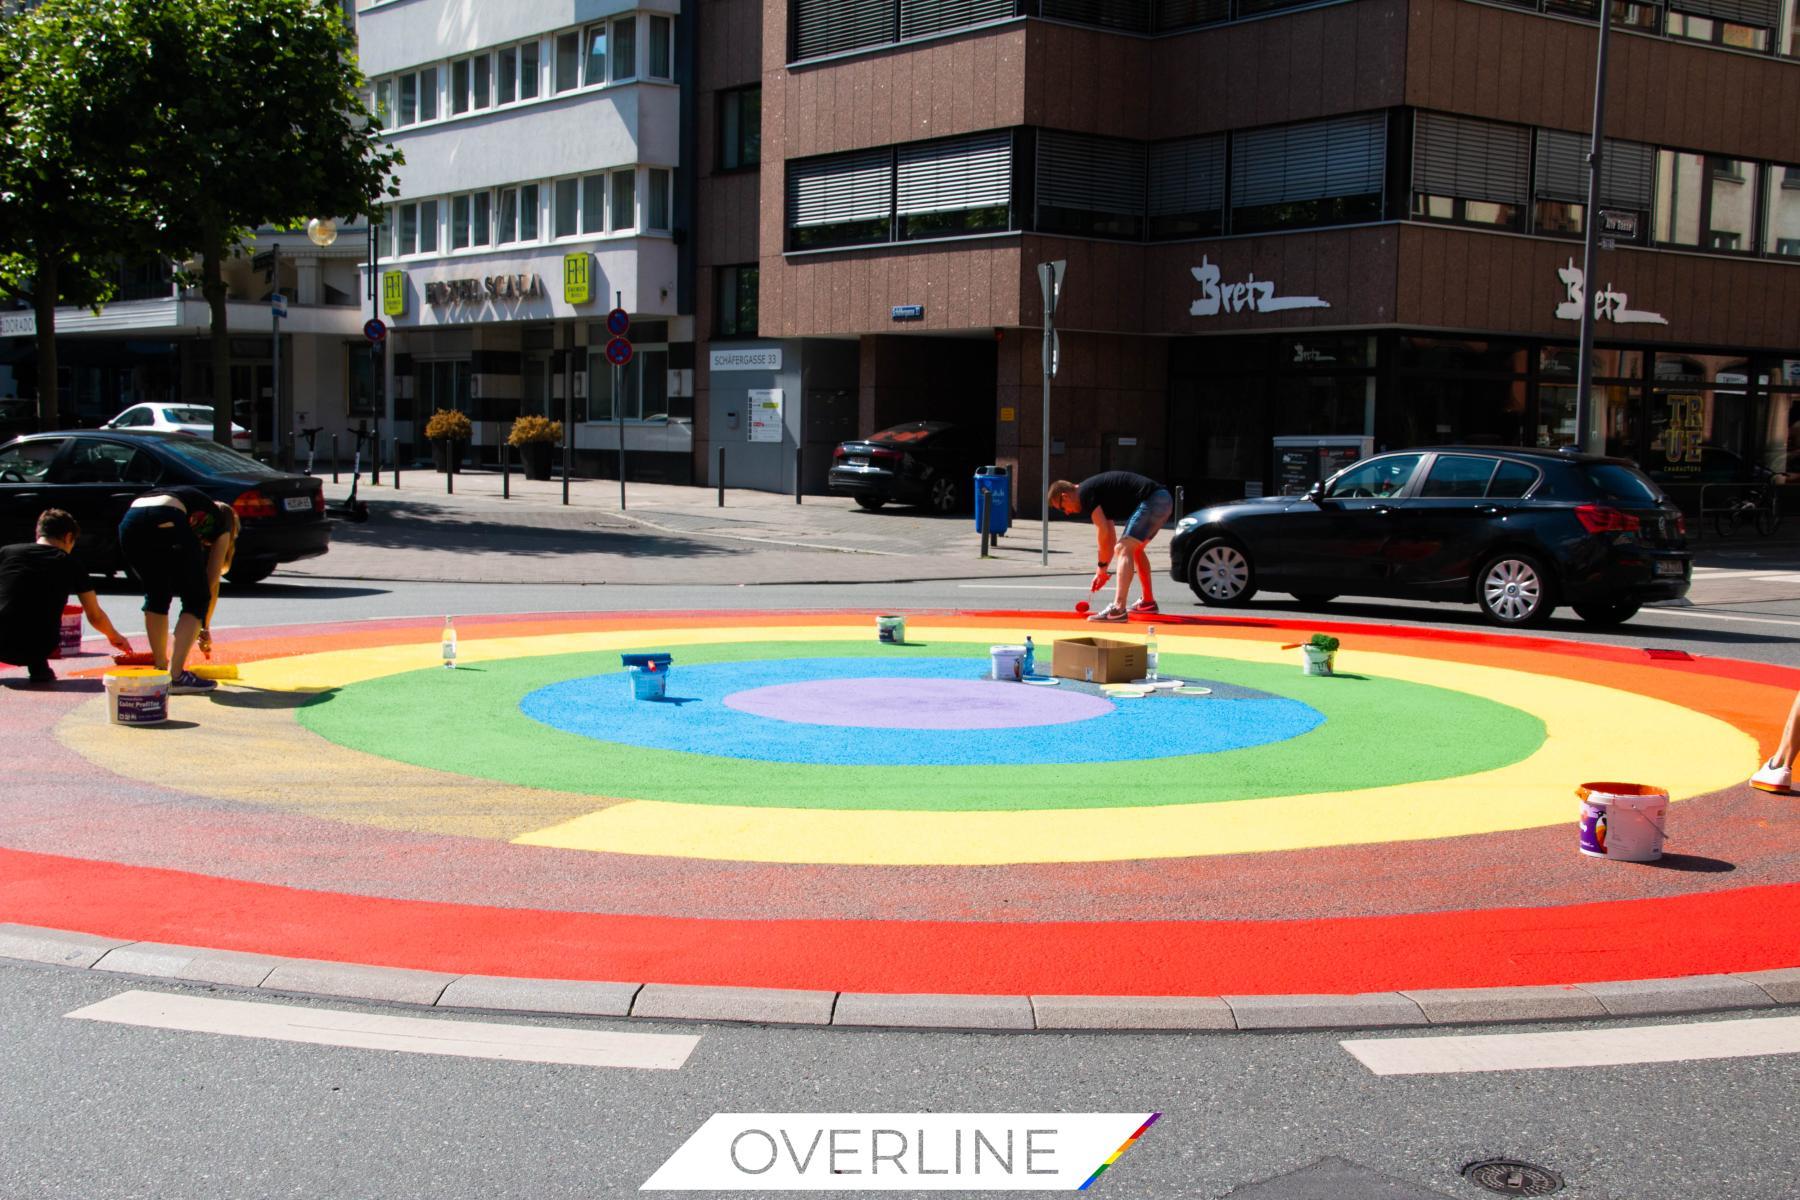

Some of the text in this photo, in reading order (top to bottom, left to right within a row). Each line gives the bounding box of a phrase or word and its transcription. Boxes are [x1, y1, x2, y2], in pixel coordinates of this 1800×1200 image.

[484, 272, 546, 299] SCALA
[1189, 253, 1331, 316] Bretz
[1555, 256, 1669, 325] Betz
[714, 353, 777, 366] SCHÄFERGASSE 33
